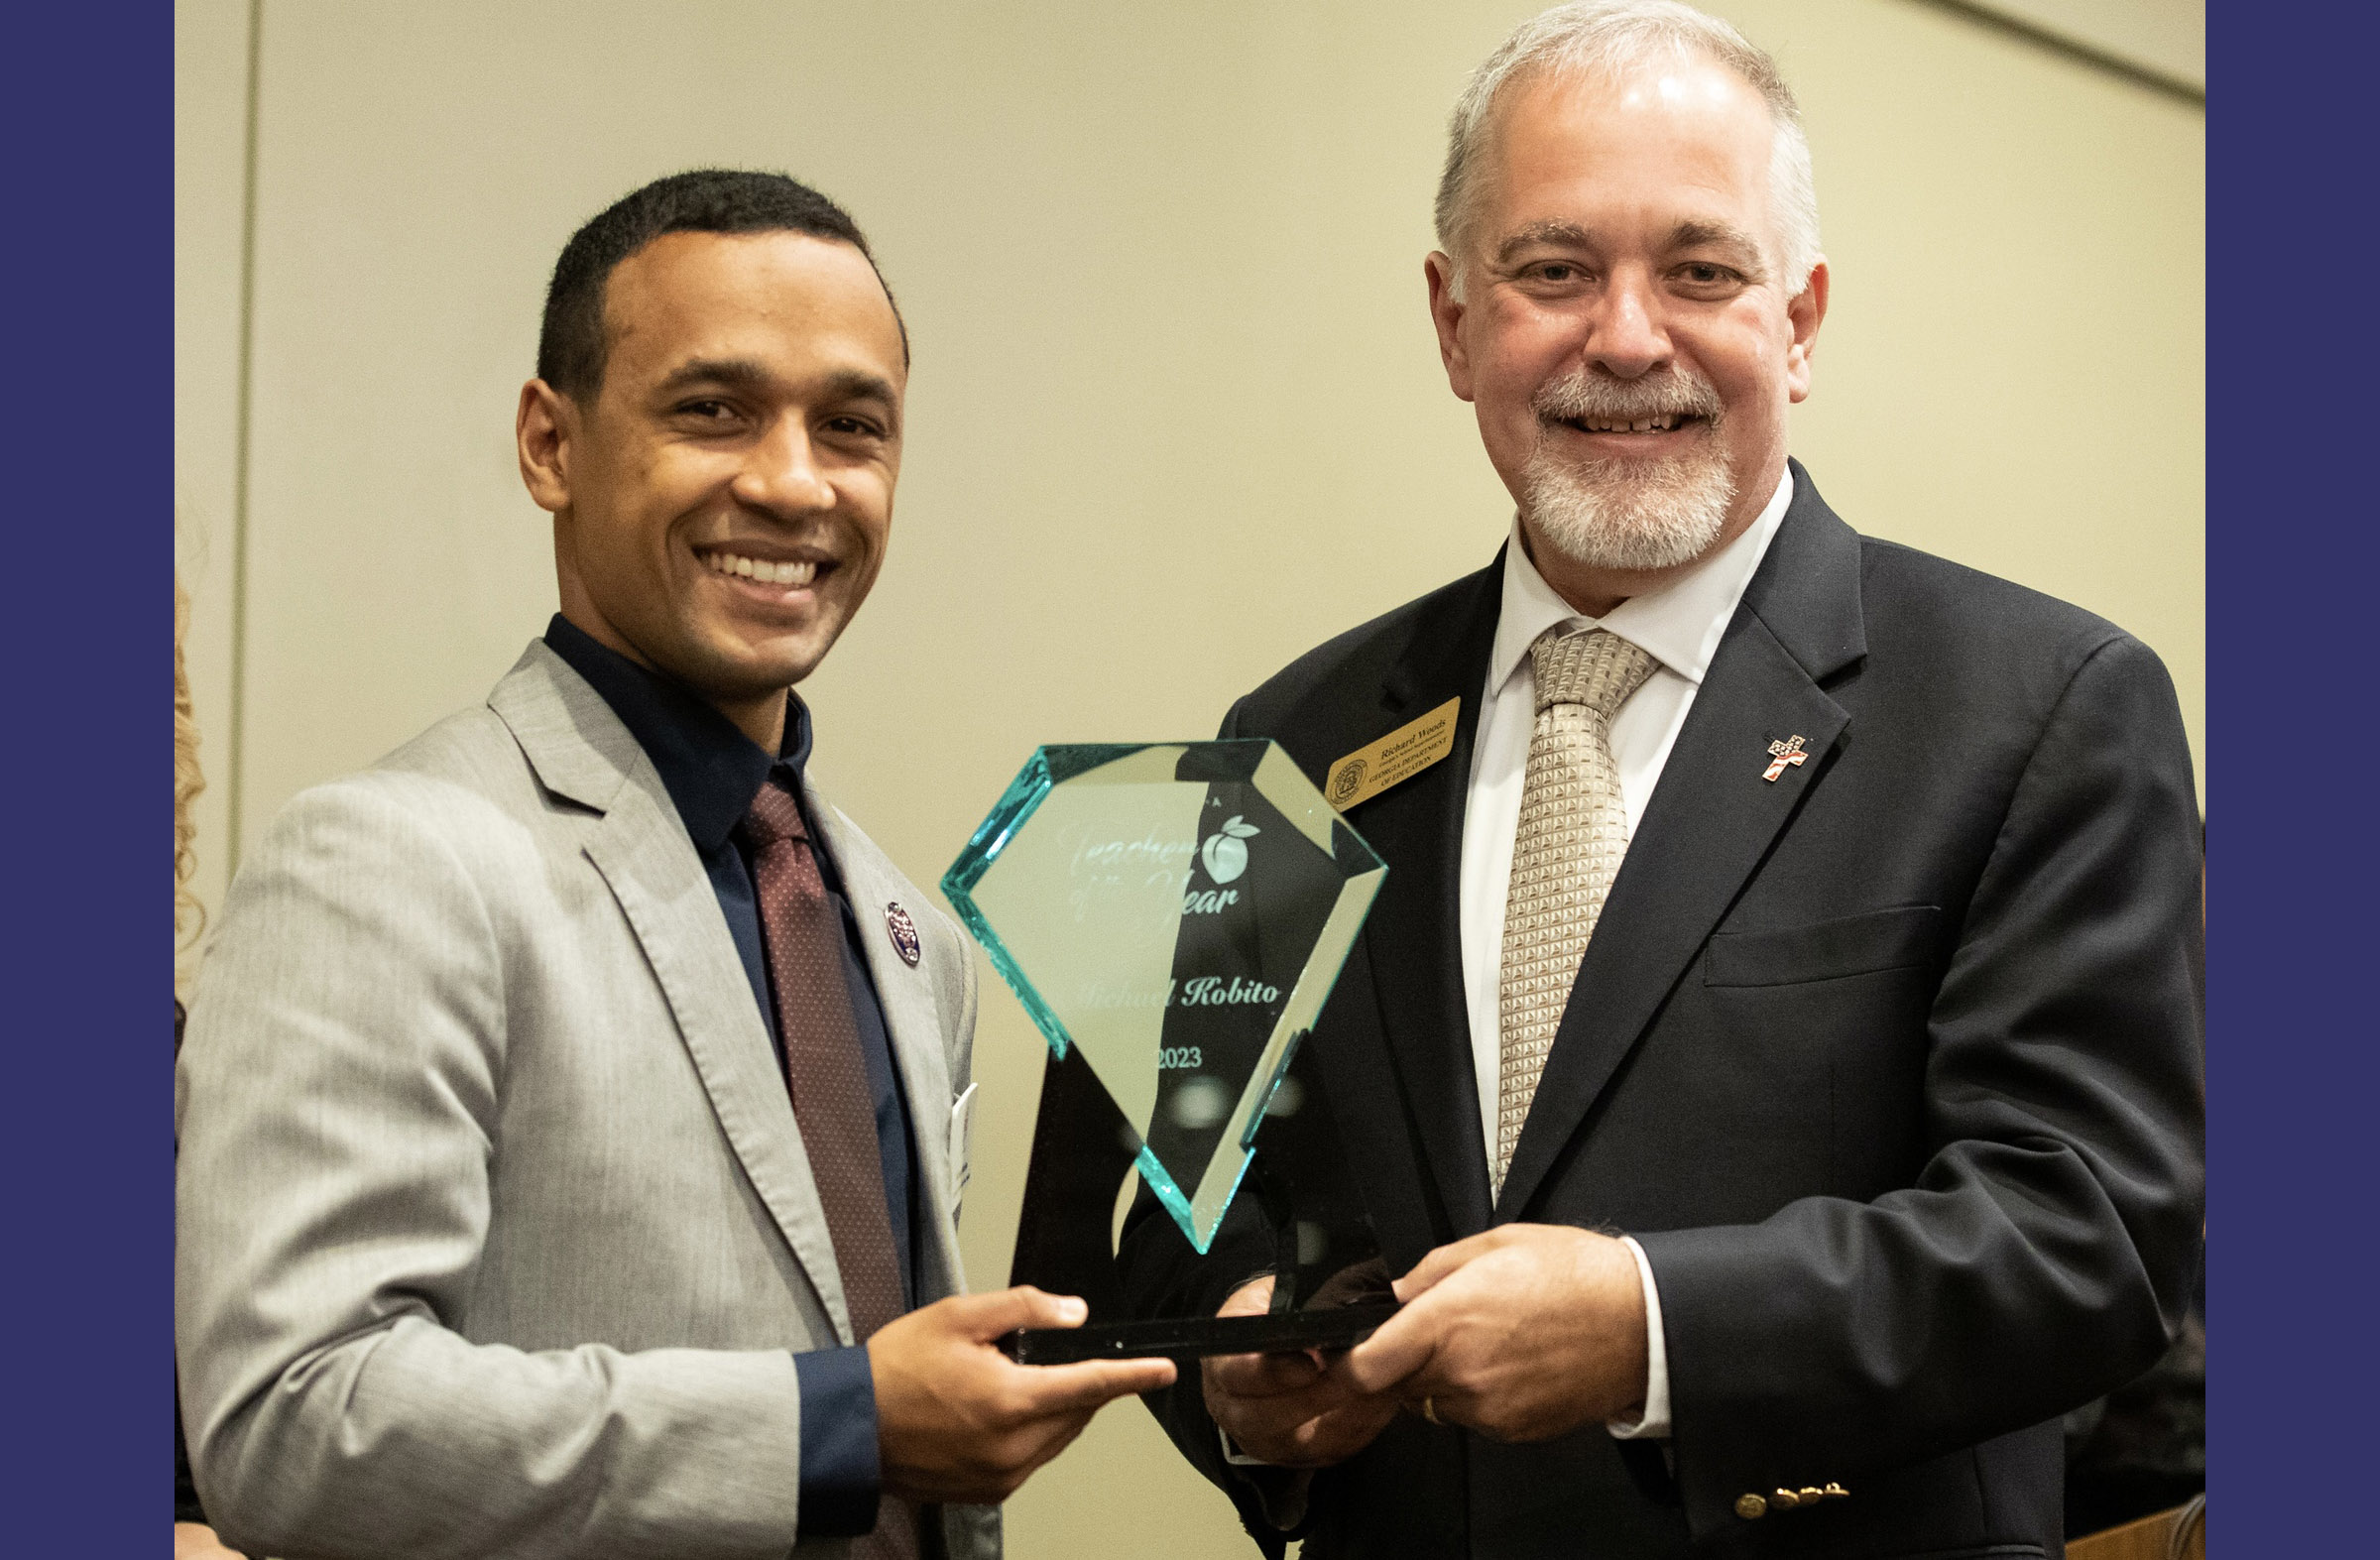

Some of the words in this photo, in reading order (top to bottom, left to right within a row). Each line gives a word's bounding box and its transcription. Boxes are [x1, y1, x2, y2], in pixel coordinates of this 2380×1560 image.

[1381, 734, 1416, 760] Richard
[1418, 719, 1447, 738] Woods
[1368, 763, 1401, 783] GEORGIA
[1402, 736, 1448, 766] DEPARTMENT
[1392, 756, 1431, 780] EDUCATION
[1181, 975, 1280, 1007] Kobito
[1158, 1045, 1203, 1070] 2023
